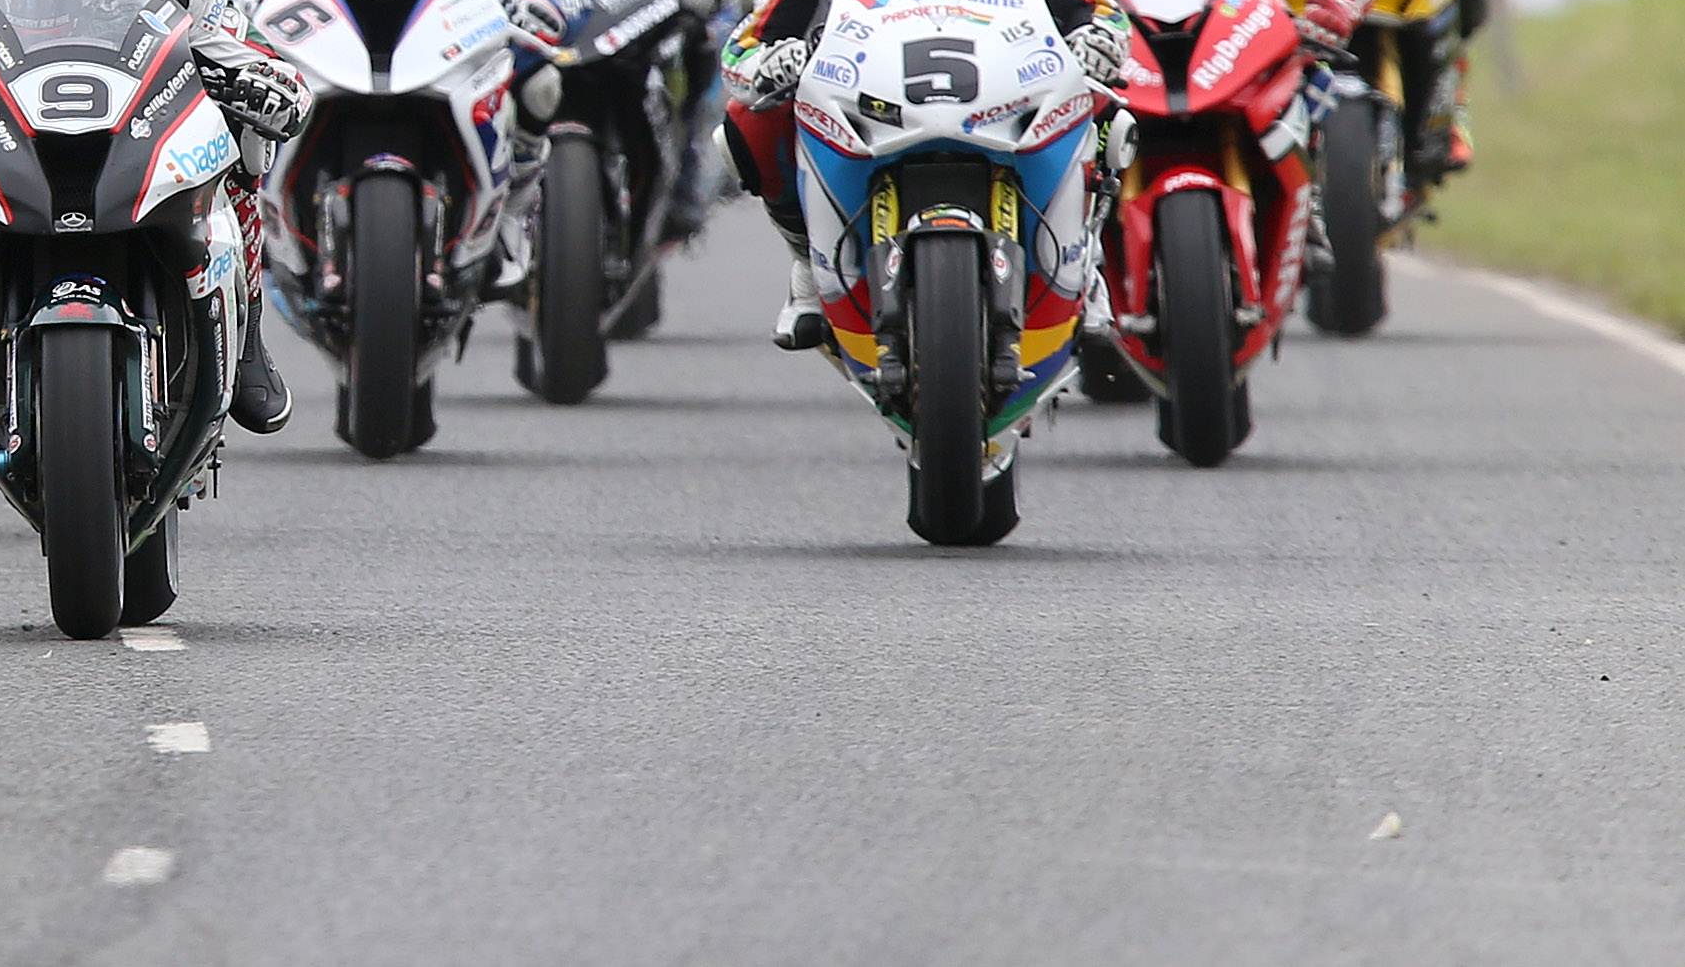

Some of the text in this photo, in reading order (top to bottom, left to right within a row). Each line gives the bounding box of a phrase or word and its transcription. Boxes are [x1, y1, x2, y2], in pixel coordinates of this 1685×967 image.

[142, 61, 197, 121] Silkolene
[813, 59, 852, 84] MMCG
[903, 37, 979, 105] 5
[39, 72, 112, 120] 9
[169, 130, 231, 178] hager
